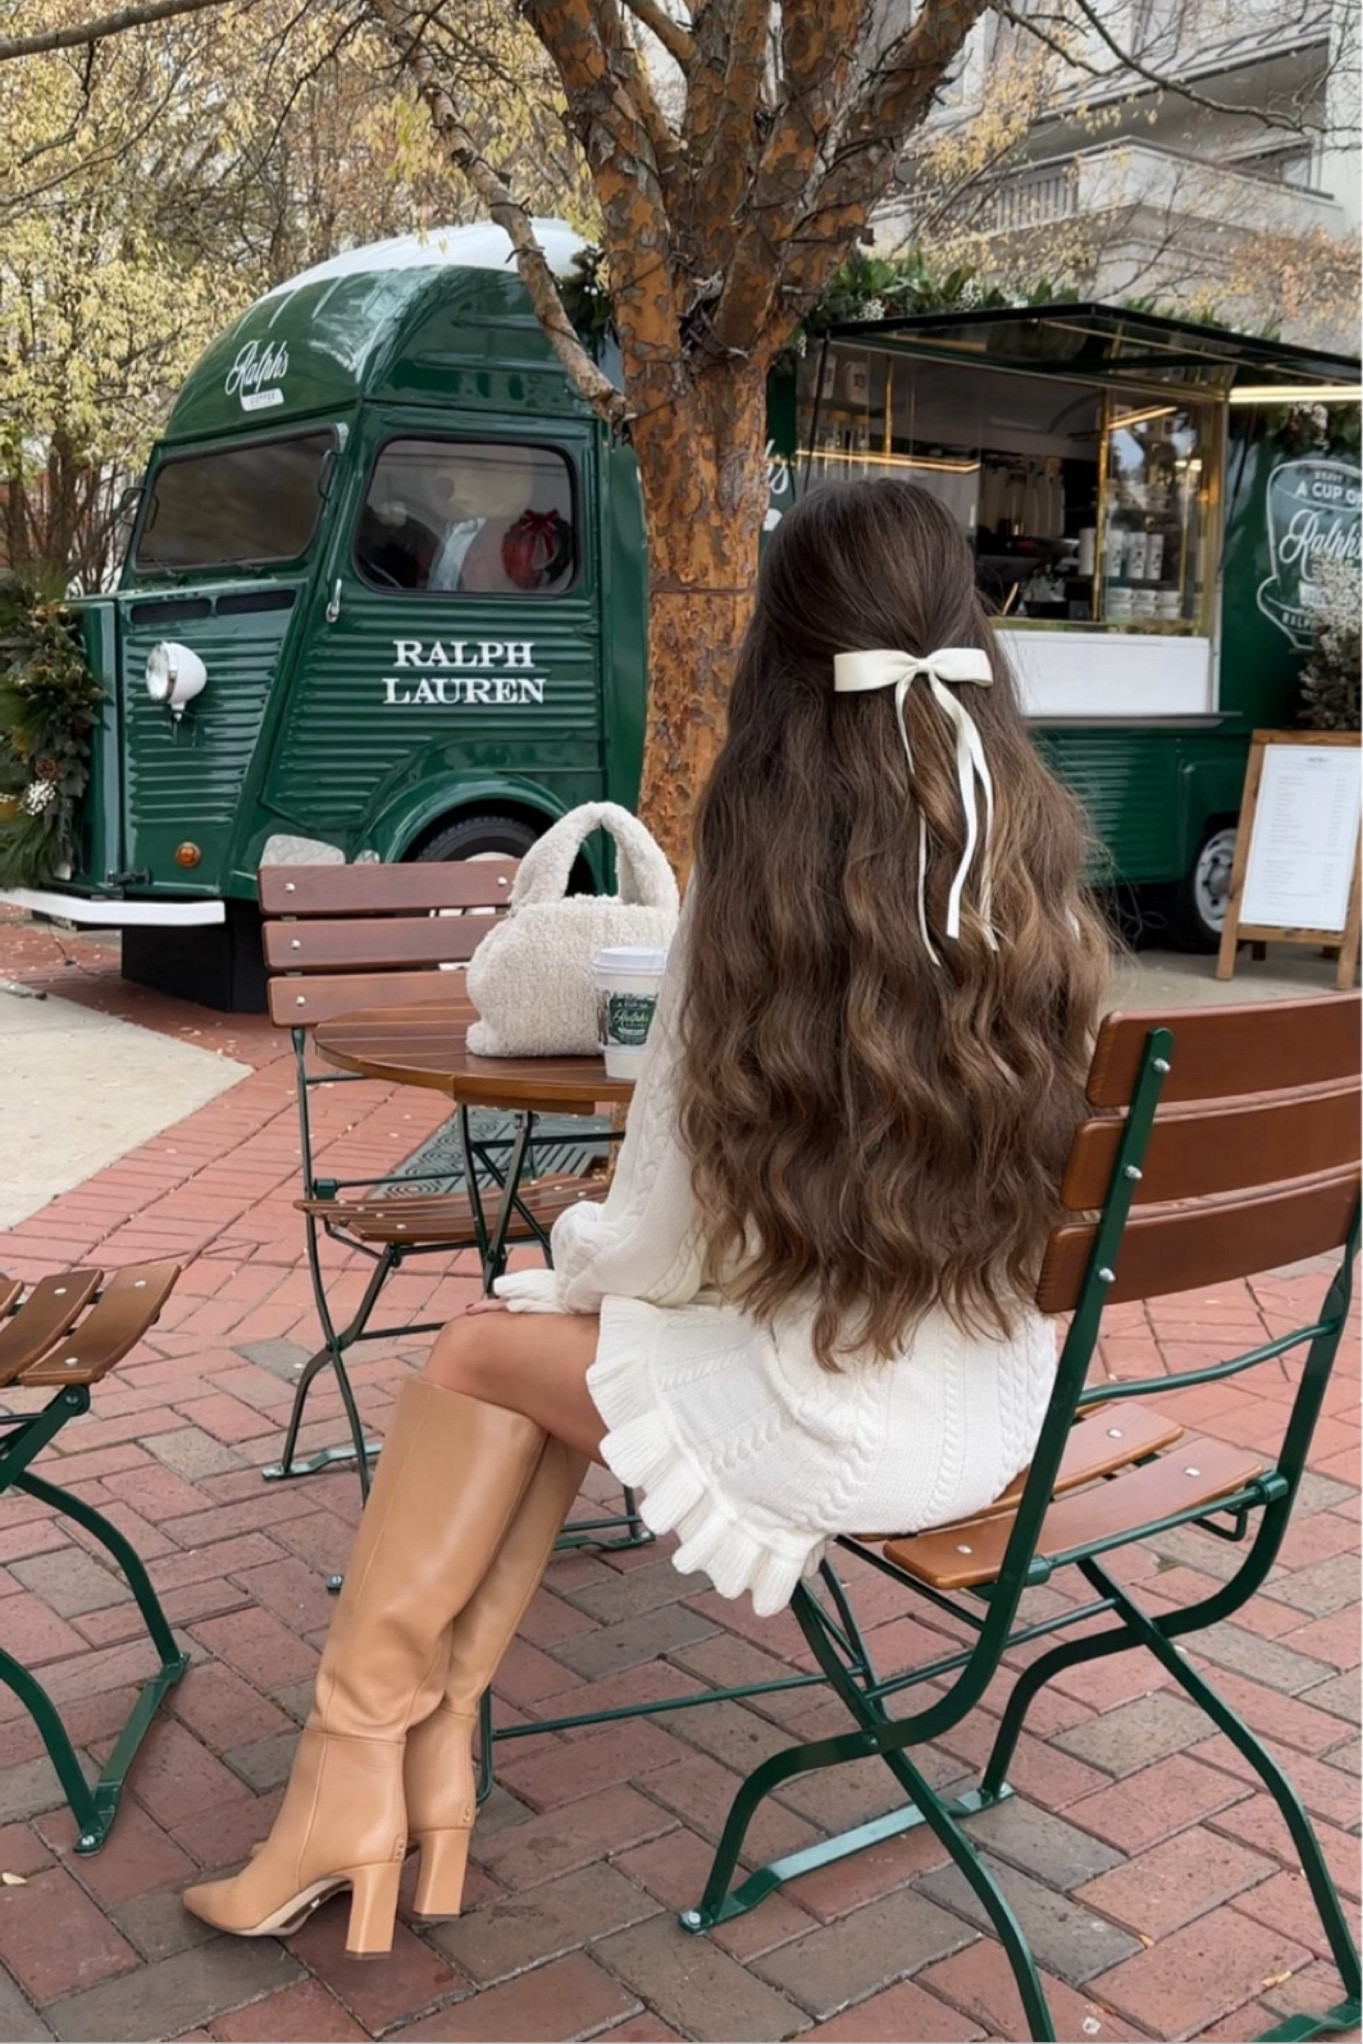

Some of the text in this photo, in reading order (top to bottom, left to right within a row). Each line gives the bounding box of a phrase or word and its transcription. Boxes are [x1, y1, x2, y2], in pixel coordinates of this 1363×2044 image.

[1295, 480, 1308, 498] A
[1312, 482, 1343, 499] CUP
[393, 640, 535, 668] RALPH
[382, 678, 547, 704] LAUREN
